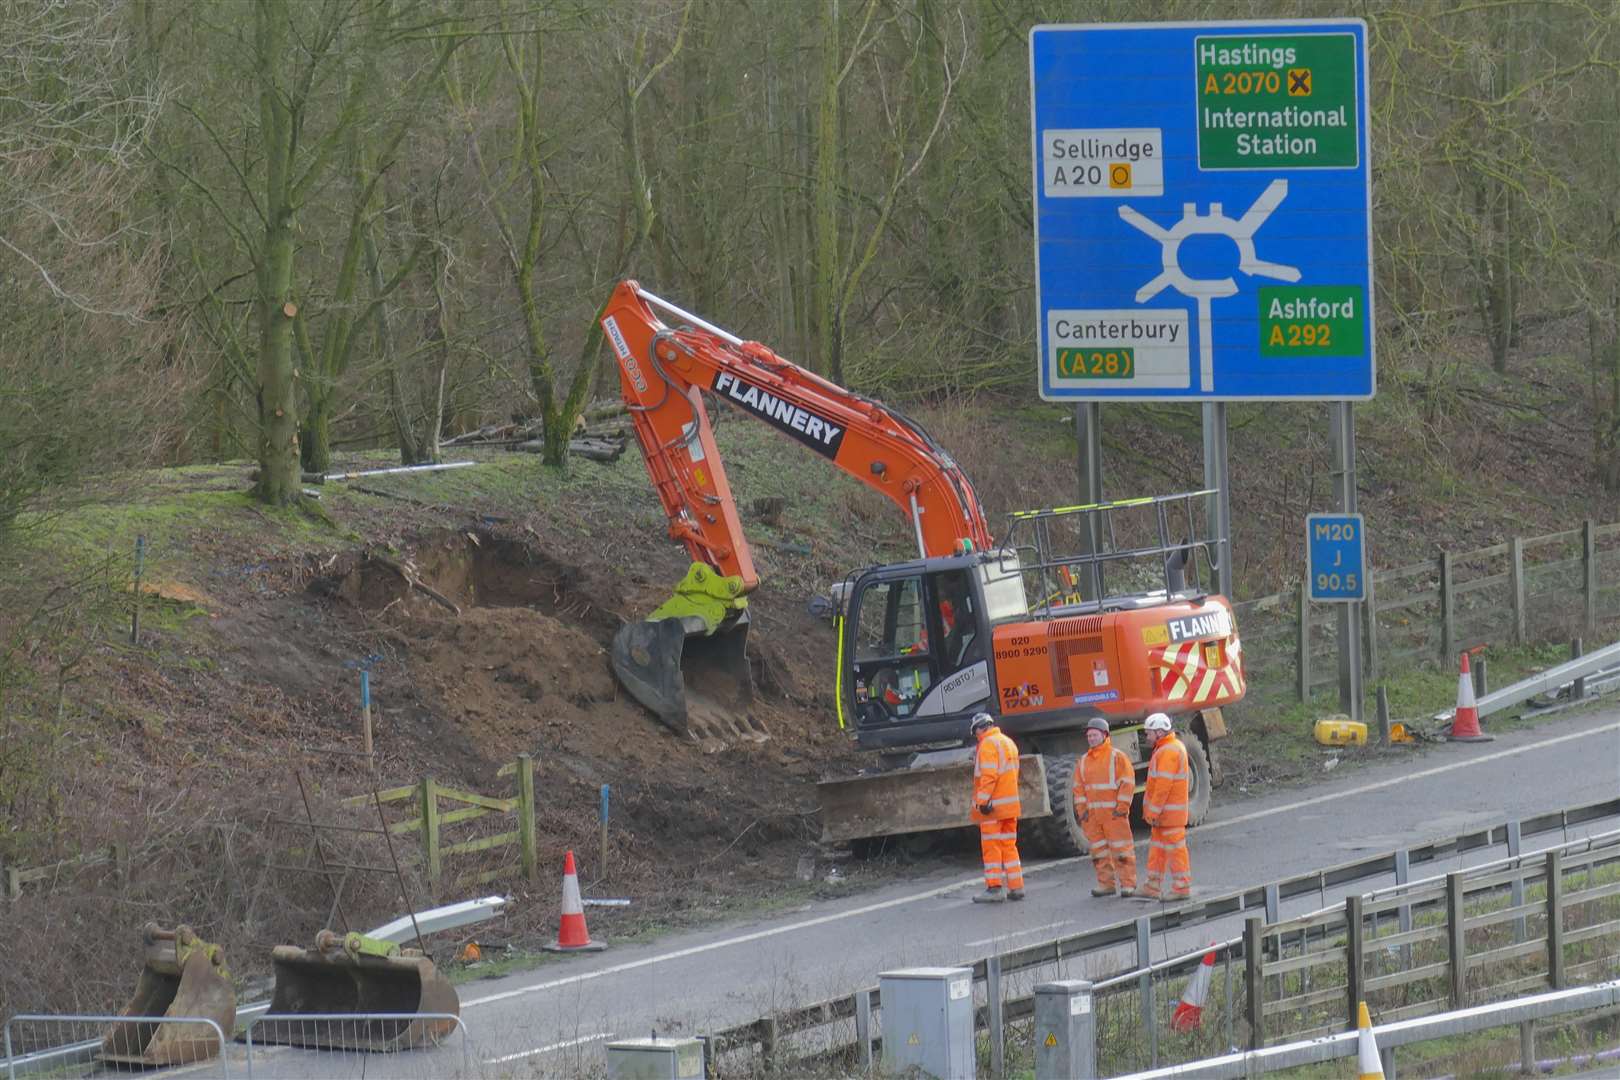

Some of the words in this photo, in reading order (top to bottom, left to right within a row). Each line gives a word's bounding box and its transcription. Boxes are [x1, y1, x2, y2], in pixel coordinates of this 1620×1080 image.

[1200, 44, 1296, 69] Hastings
[1204, 72, 1280, 95] A2070
[1204, 106, 1347, 129] International
[1052, 138, 1154, 162] Sellindge
[1236, 134, 1317, 156] Station
[1053, 166, 1102, 186] A20
[1268, 297, 1355, 320] Ashford
[605, 318, 628, 357] HITACHI
[1055, 319, 1180, 345] Canterbury
[1269, 324, 1331, 347] A292
[1059, 350, 1132, 377] (A28)
[715, 371, 841, 446] FLANNERY
[1315, 524, 1354, 541] M20
[1333, 550, 1342, 567] J
[1317, 574, 1357, 592] 90.5
[1011, 636, 1030, 646] 020
[1003, 682, 1040, 698] ZAXIS
